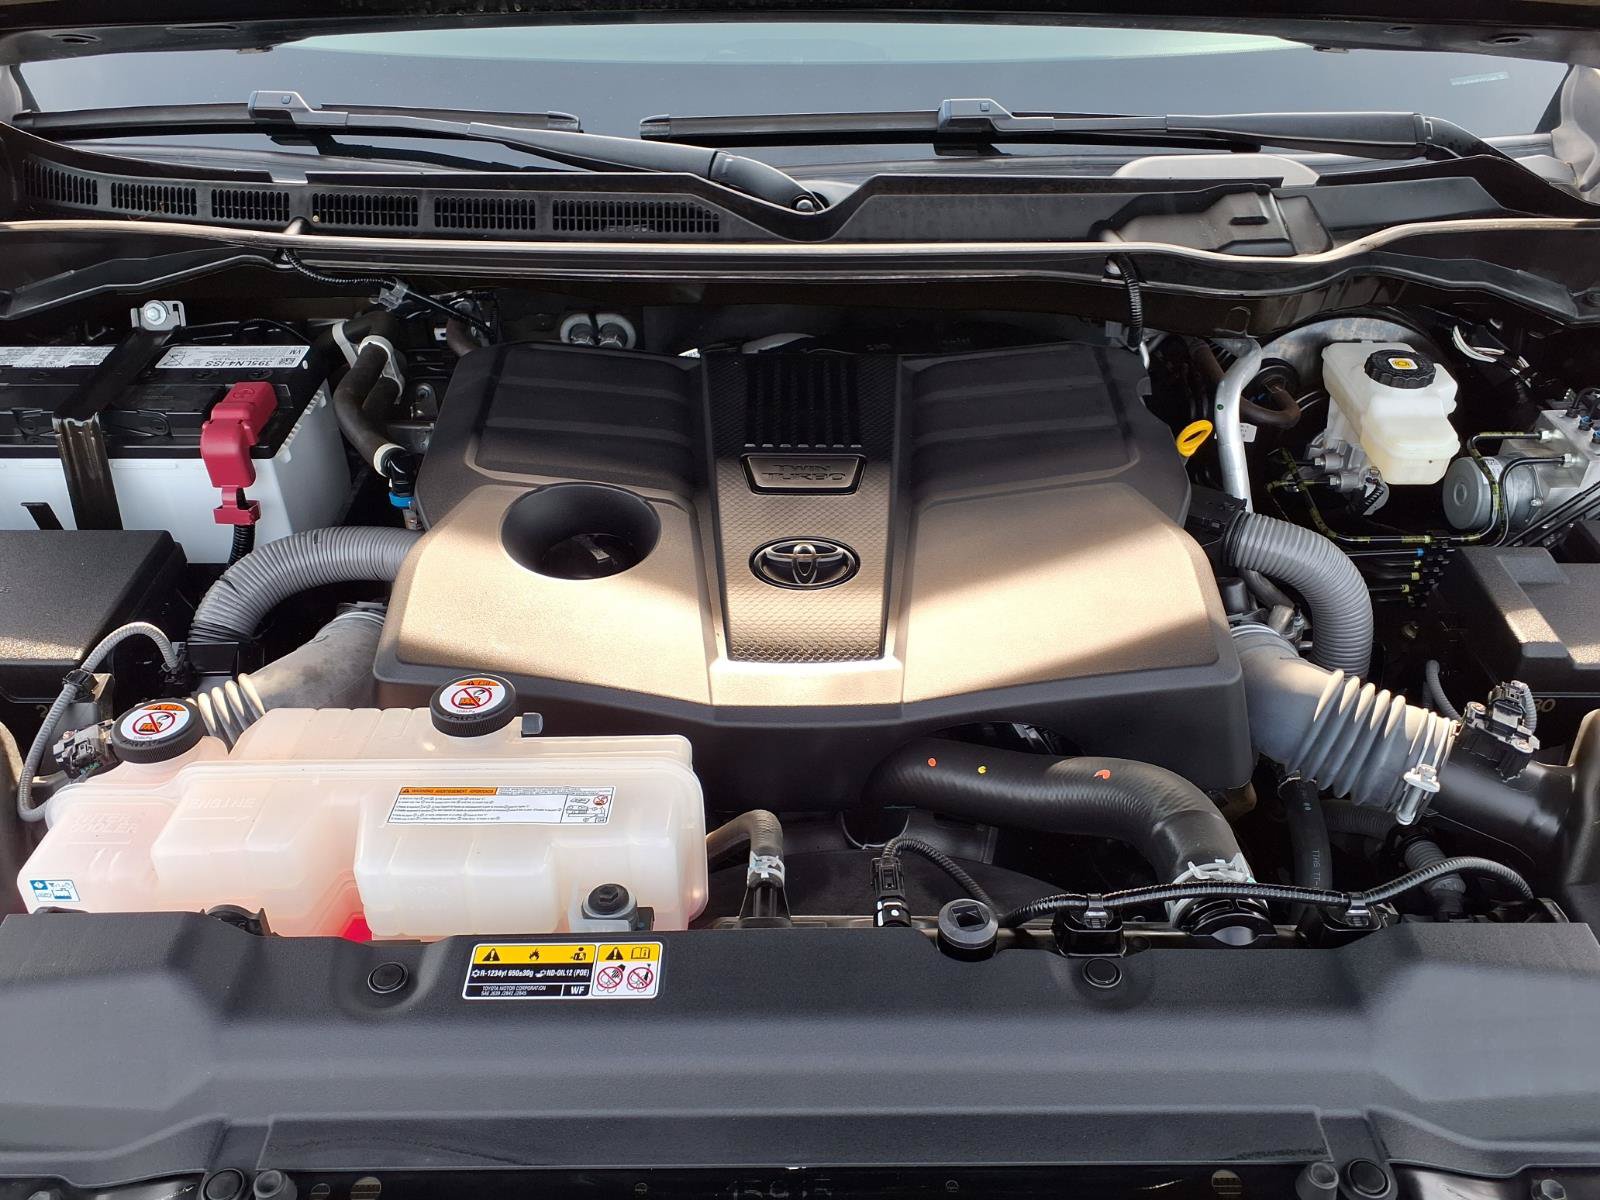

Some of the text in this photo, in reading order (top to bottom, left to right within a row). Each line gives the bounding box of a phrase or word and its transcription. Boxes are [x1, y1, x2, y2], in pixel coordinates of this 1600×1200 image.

[771, 464, 832, 472] TWIN
[761, 472, 847, 481] TURBO
[480, 969, 507, 978] R-1234yf
[573, 969, 590, 978] (POE)
[570, 986, 585, 995] WF
